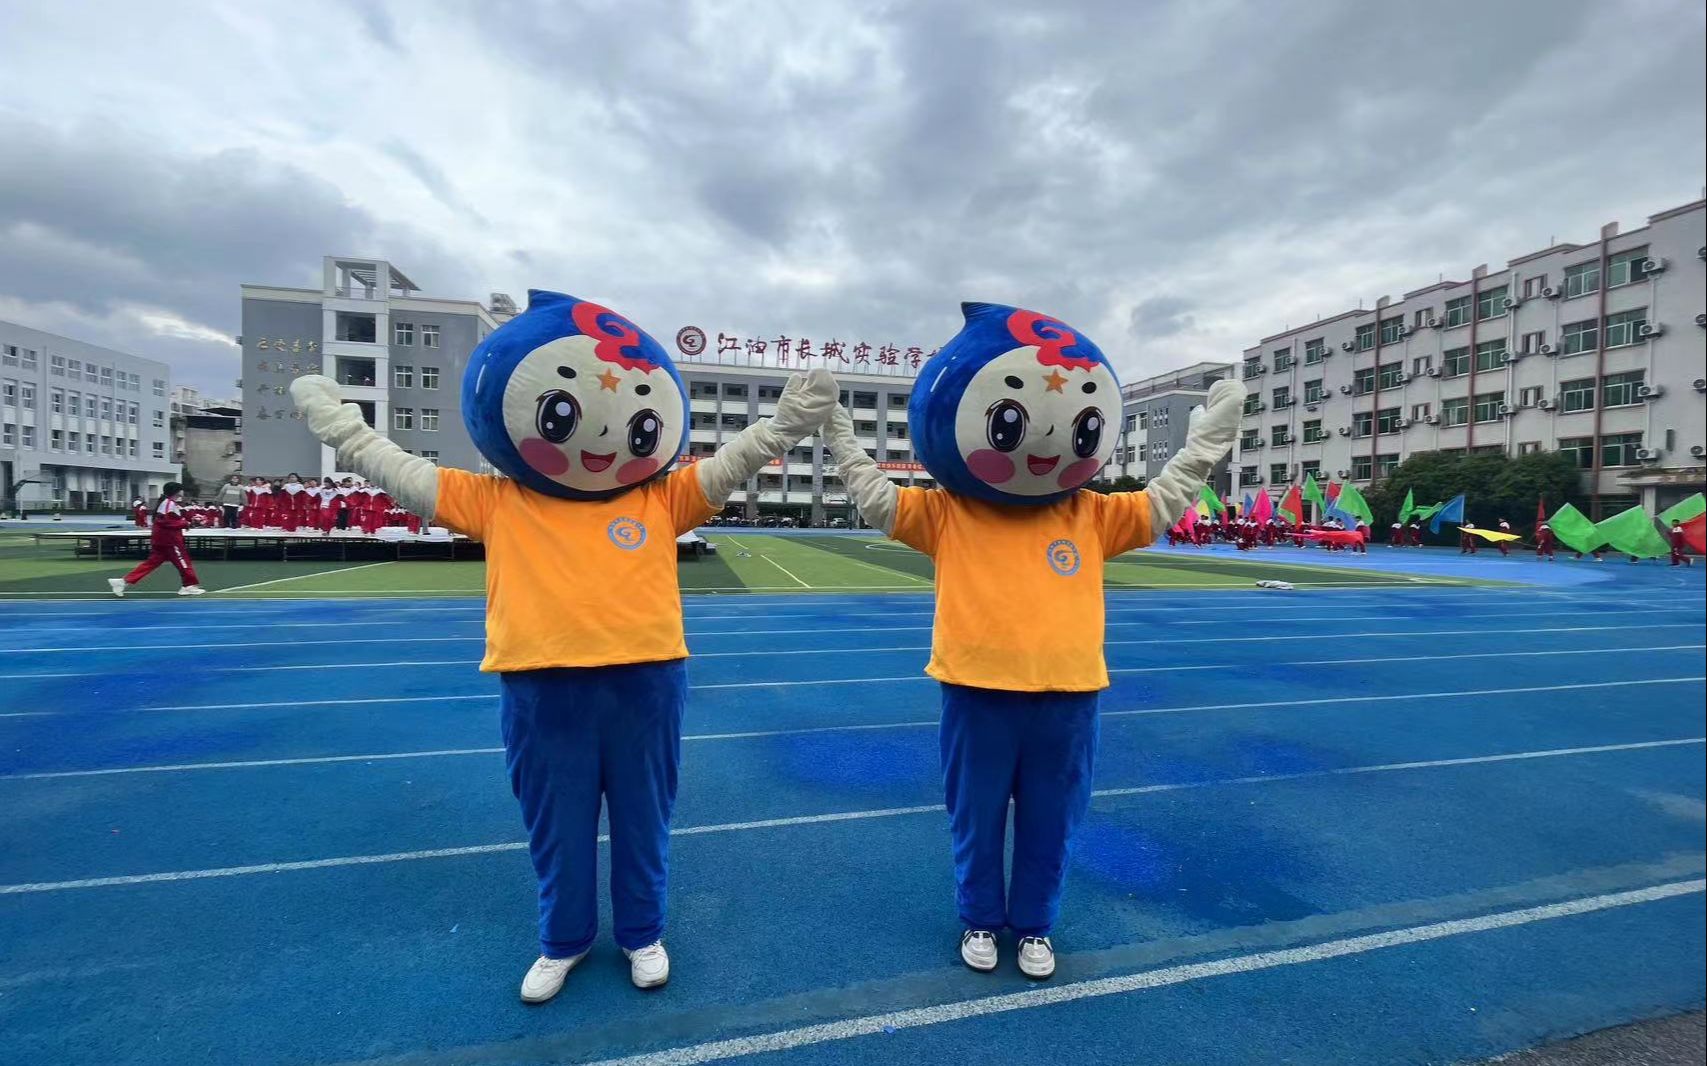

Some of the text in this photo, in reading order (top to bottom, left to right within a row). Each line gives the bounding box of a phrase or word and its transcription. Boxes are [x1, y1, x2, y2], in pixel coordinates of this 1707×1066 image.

[718, 332, 940, 368] 江油市长城实验学
